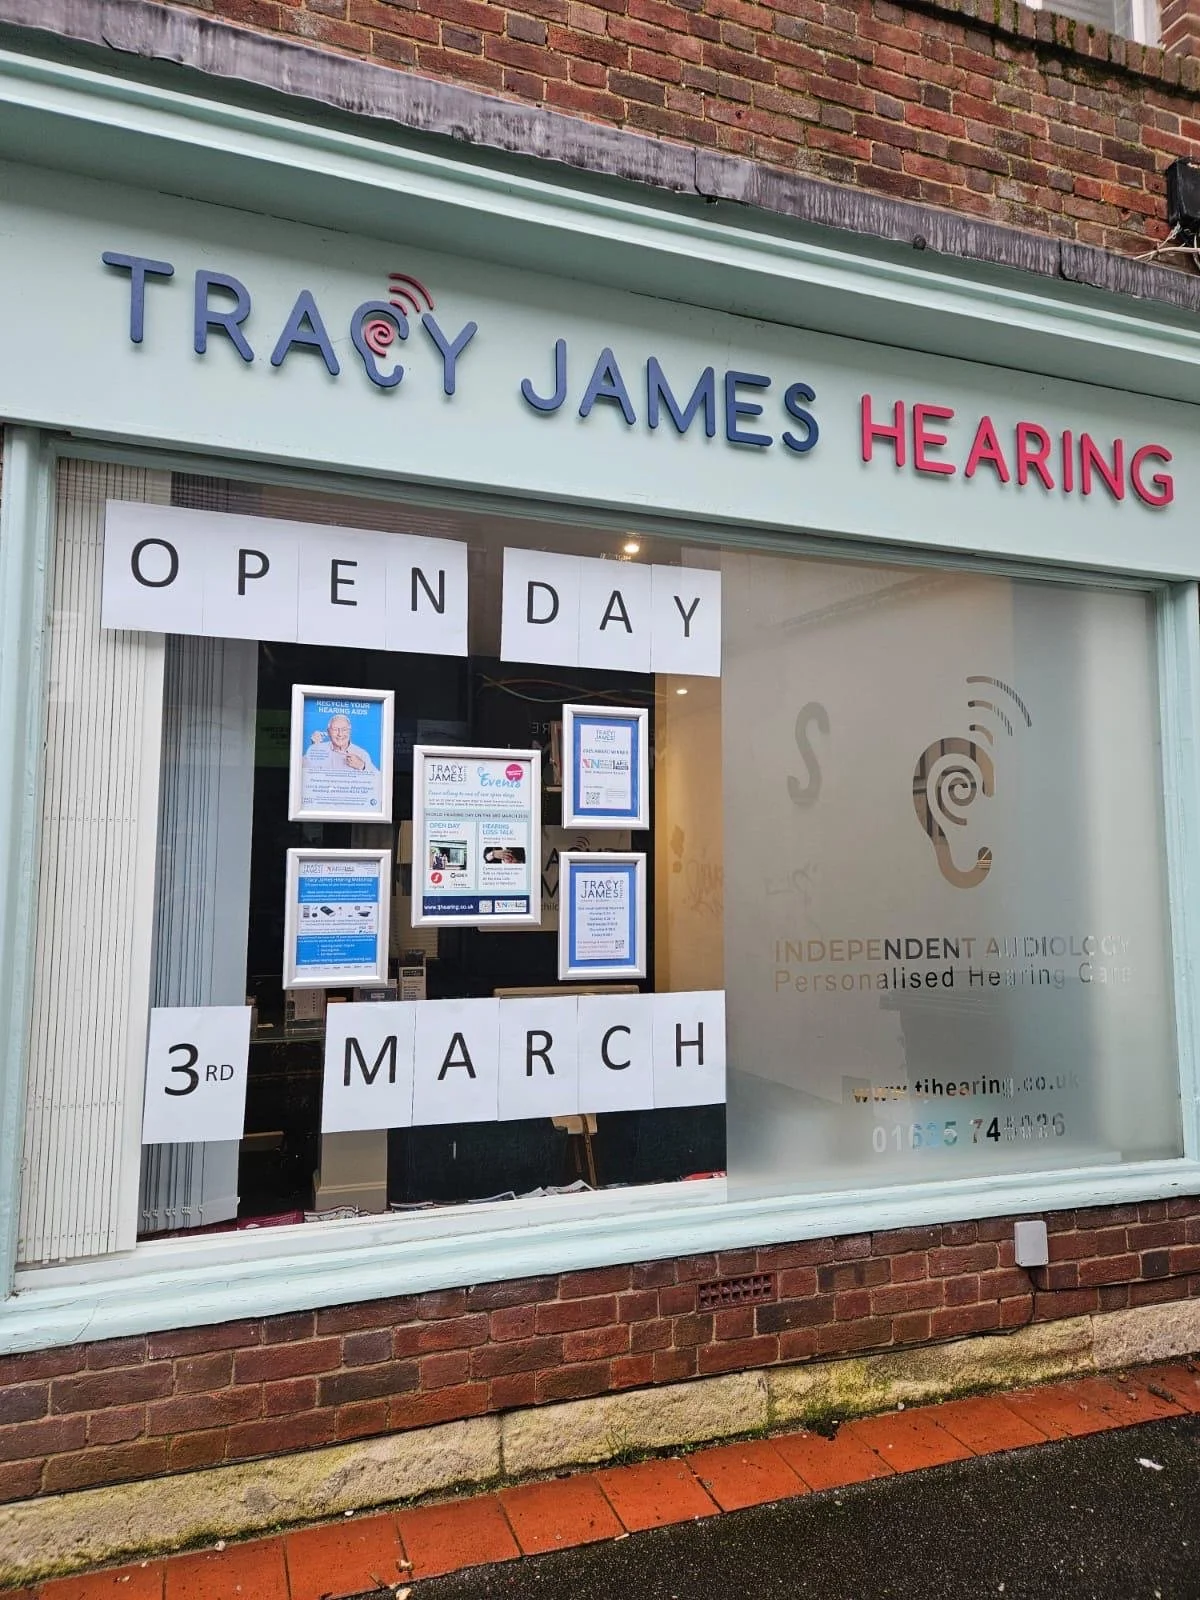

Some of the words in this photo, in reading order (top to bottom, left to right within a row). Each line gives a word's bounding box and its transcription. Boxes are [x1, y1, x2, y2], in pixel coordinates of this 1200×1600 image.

[102, 252, 478, 396] TRACY
[521, 338, 819, 452] JAMES
[861, 394, 1175, 506] HEARING
[131, 538, 446, 615] OPEN
[527, 580, 701, 638] DAY
[316, 700, 349, 708] RECYCLE
[429, 764, 464, 774] TRACY
[428, 773, 464, 782] JAMES
[480, 772, 521, 788] Events
[581, 880, 619, 889] TRACY
[580, 889, 618, 898] JAMES
[775, 937, 976, 962] INDEPENDENT
[986, 935, 1130, 958] AUDIOLOGY
[775, 965, 954, 992] Personalised
[968, 962, 1065, 990] Hearing
[1078, 961, 1132, 985] Care
[343, 1021, 704, 1087] MARCH
